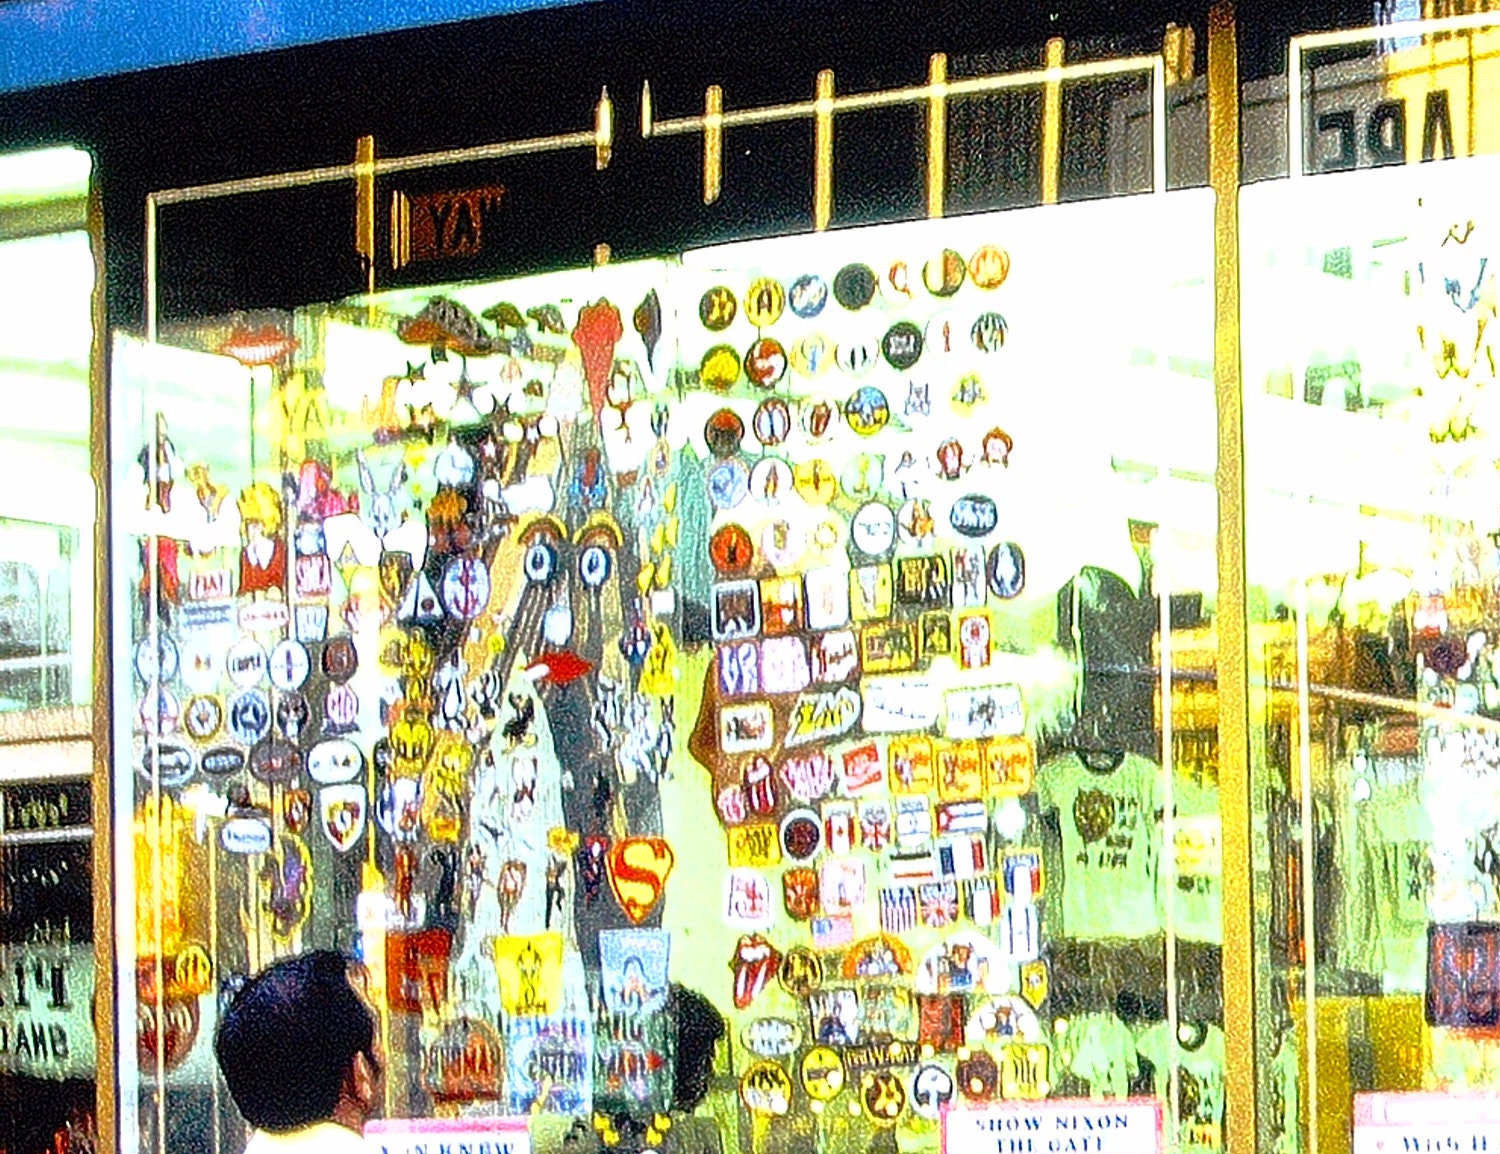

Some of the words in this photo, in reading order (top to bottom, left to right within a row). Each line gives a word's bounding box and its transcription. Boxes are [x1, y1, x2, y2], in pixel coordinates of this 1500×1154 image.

[976, 1116, 1043, 1132] SHOW
[1056, 1114, 1128, 1131] NIXON
[997, 1137, 1037, 1154] THE
[1048, 1136, 1104, 1153] GATE
